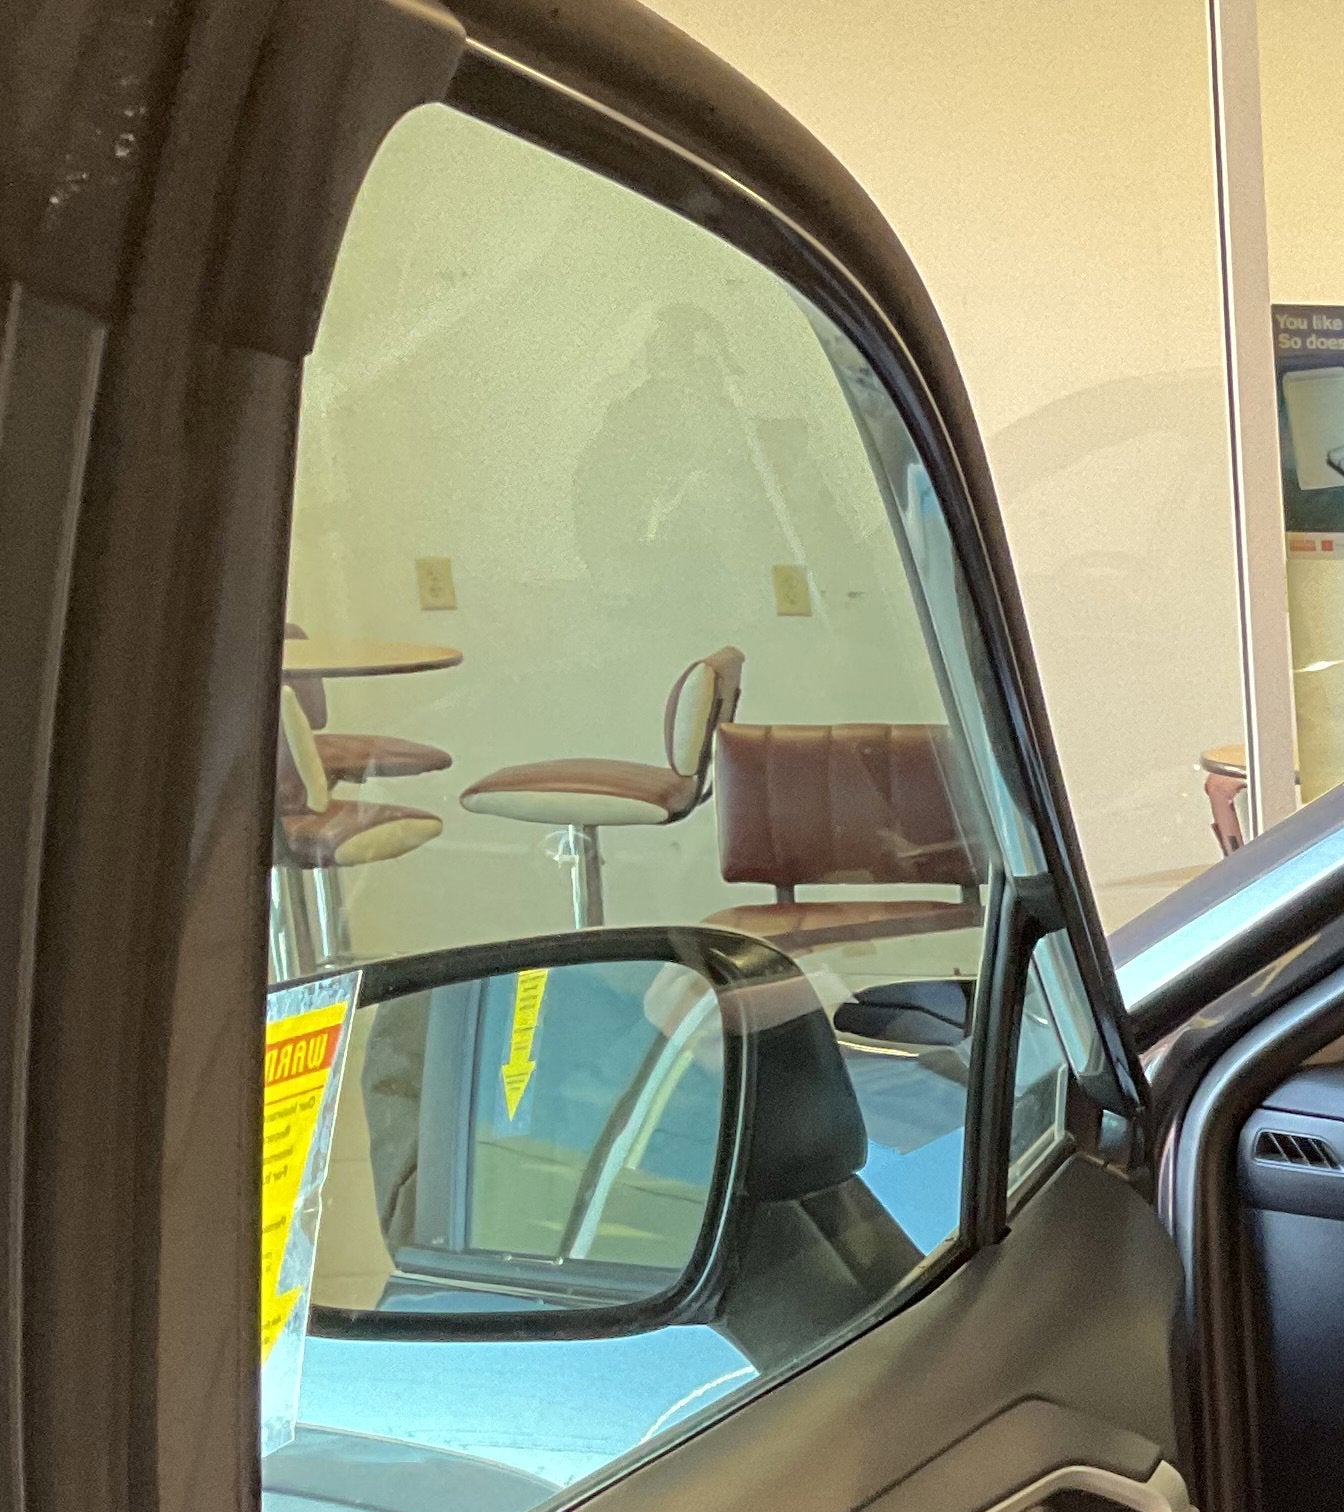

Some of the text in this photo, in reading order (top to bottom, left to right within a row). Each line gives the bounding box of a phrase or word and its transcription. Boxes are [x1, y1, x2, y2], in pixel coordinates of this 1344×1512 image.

[1275, 314, 1307, 330] You
[1312, 315, 1342, 331] like
[1278, 333, 1302, 349] So
